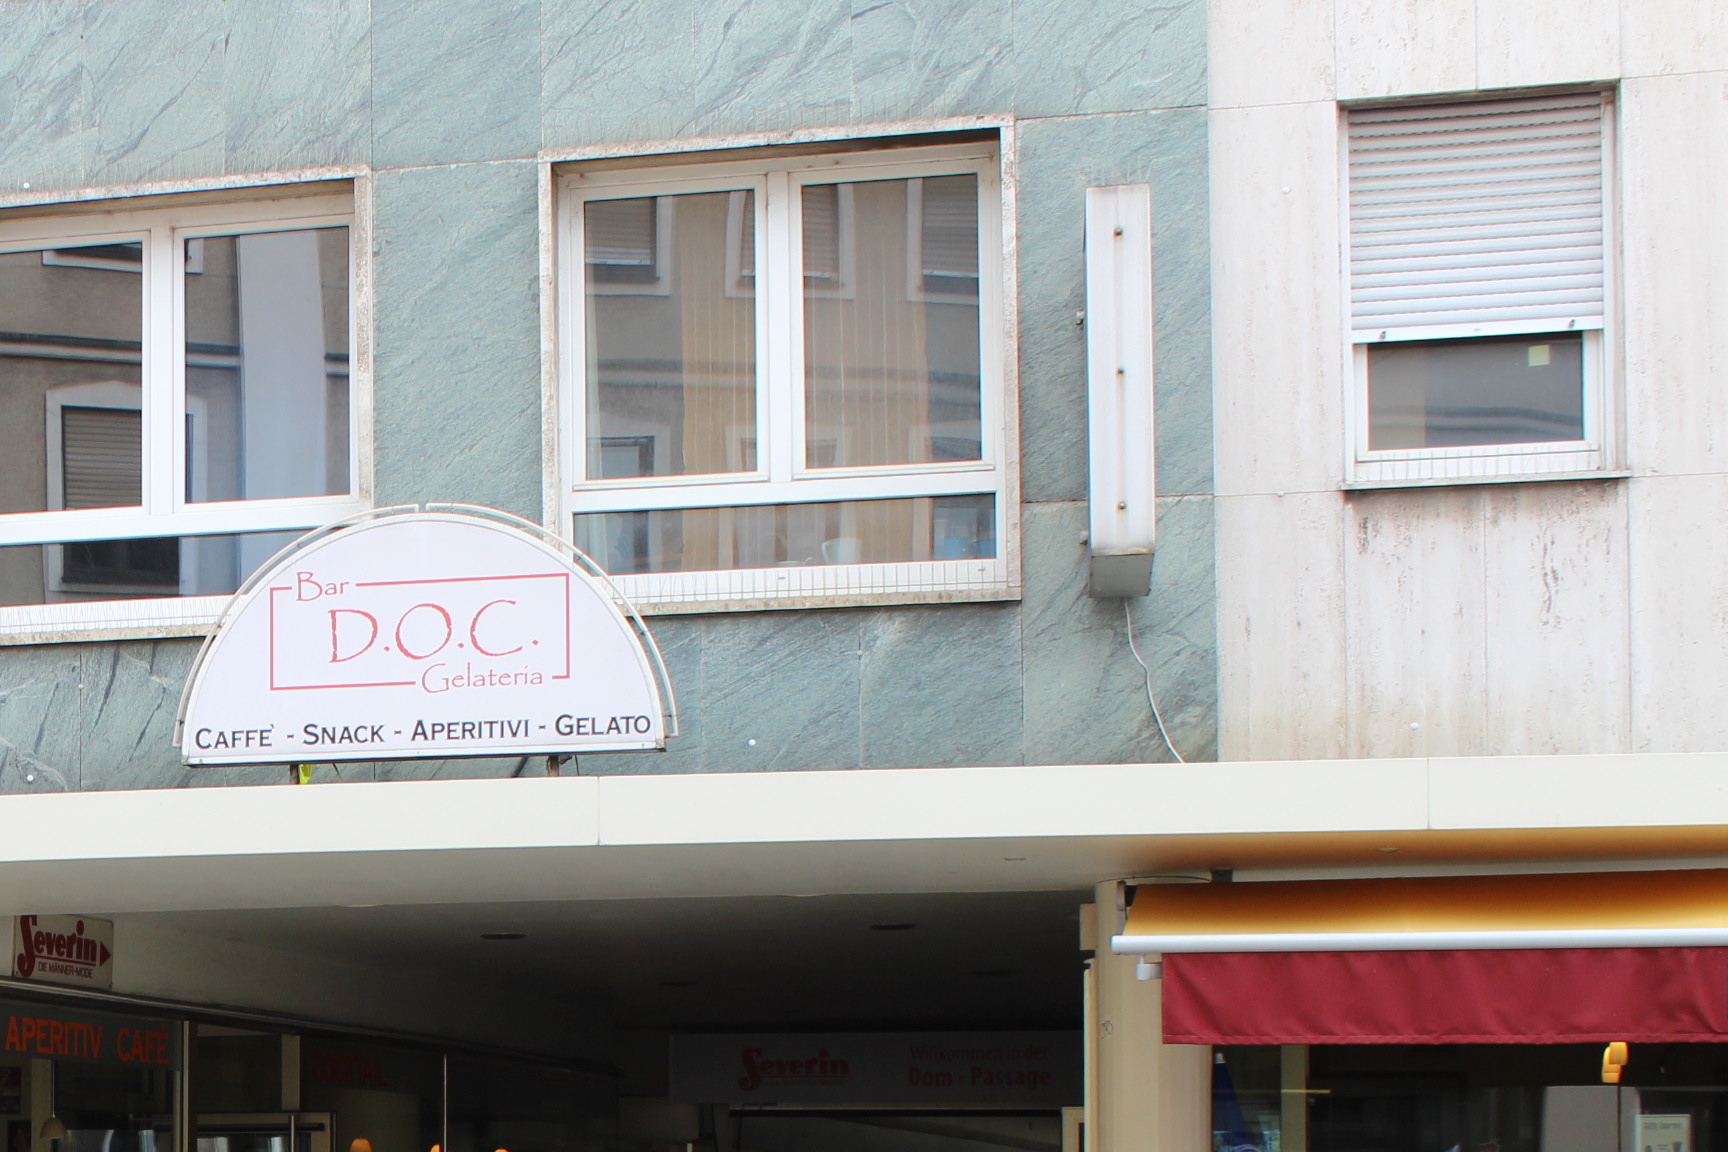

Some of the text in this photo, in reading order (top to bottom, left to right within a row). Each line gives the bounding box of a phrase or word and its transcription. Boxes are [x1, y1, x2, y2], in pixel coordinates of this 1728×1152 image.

[295, 571, 350, 602] Bar
[328, 600, 539, 663] D.O.C.
[421, 663, 544, 693] Gelateria
[17, 915, 98, 977] Severin
[4, 1015, 104, 1059] APERITIV
[910, 1044, 1049, 1061] Willkommen in der
[311, 1052, 388, 1087] COCKTAIL
[738, 1047, 850, 1091] Severin
[908, 1067, 953, 1087] Dom
[972, 1066, 1052, 1089] Passage
